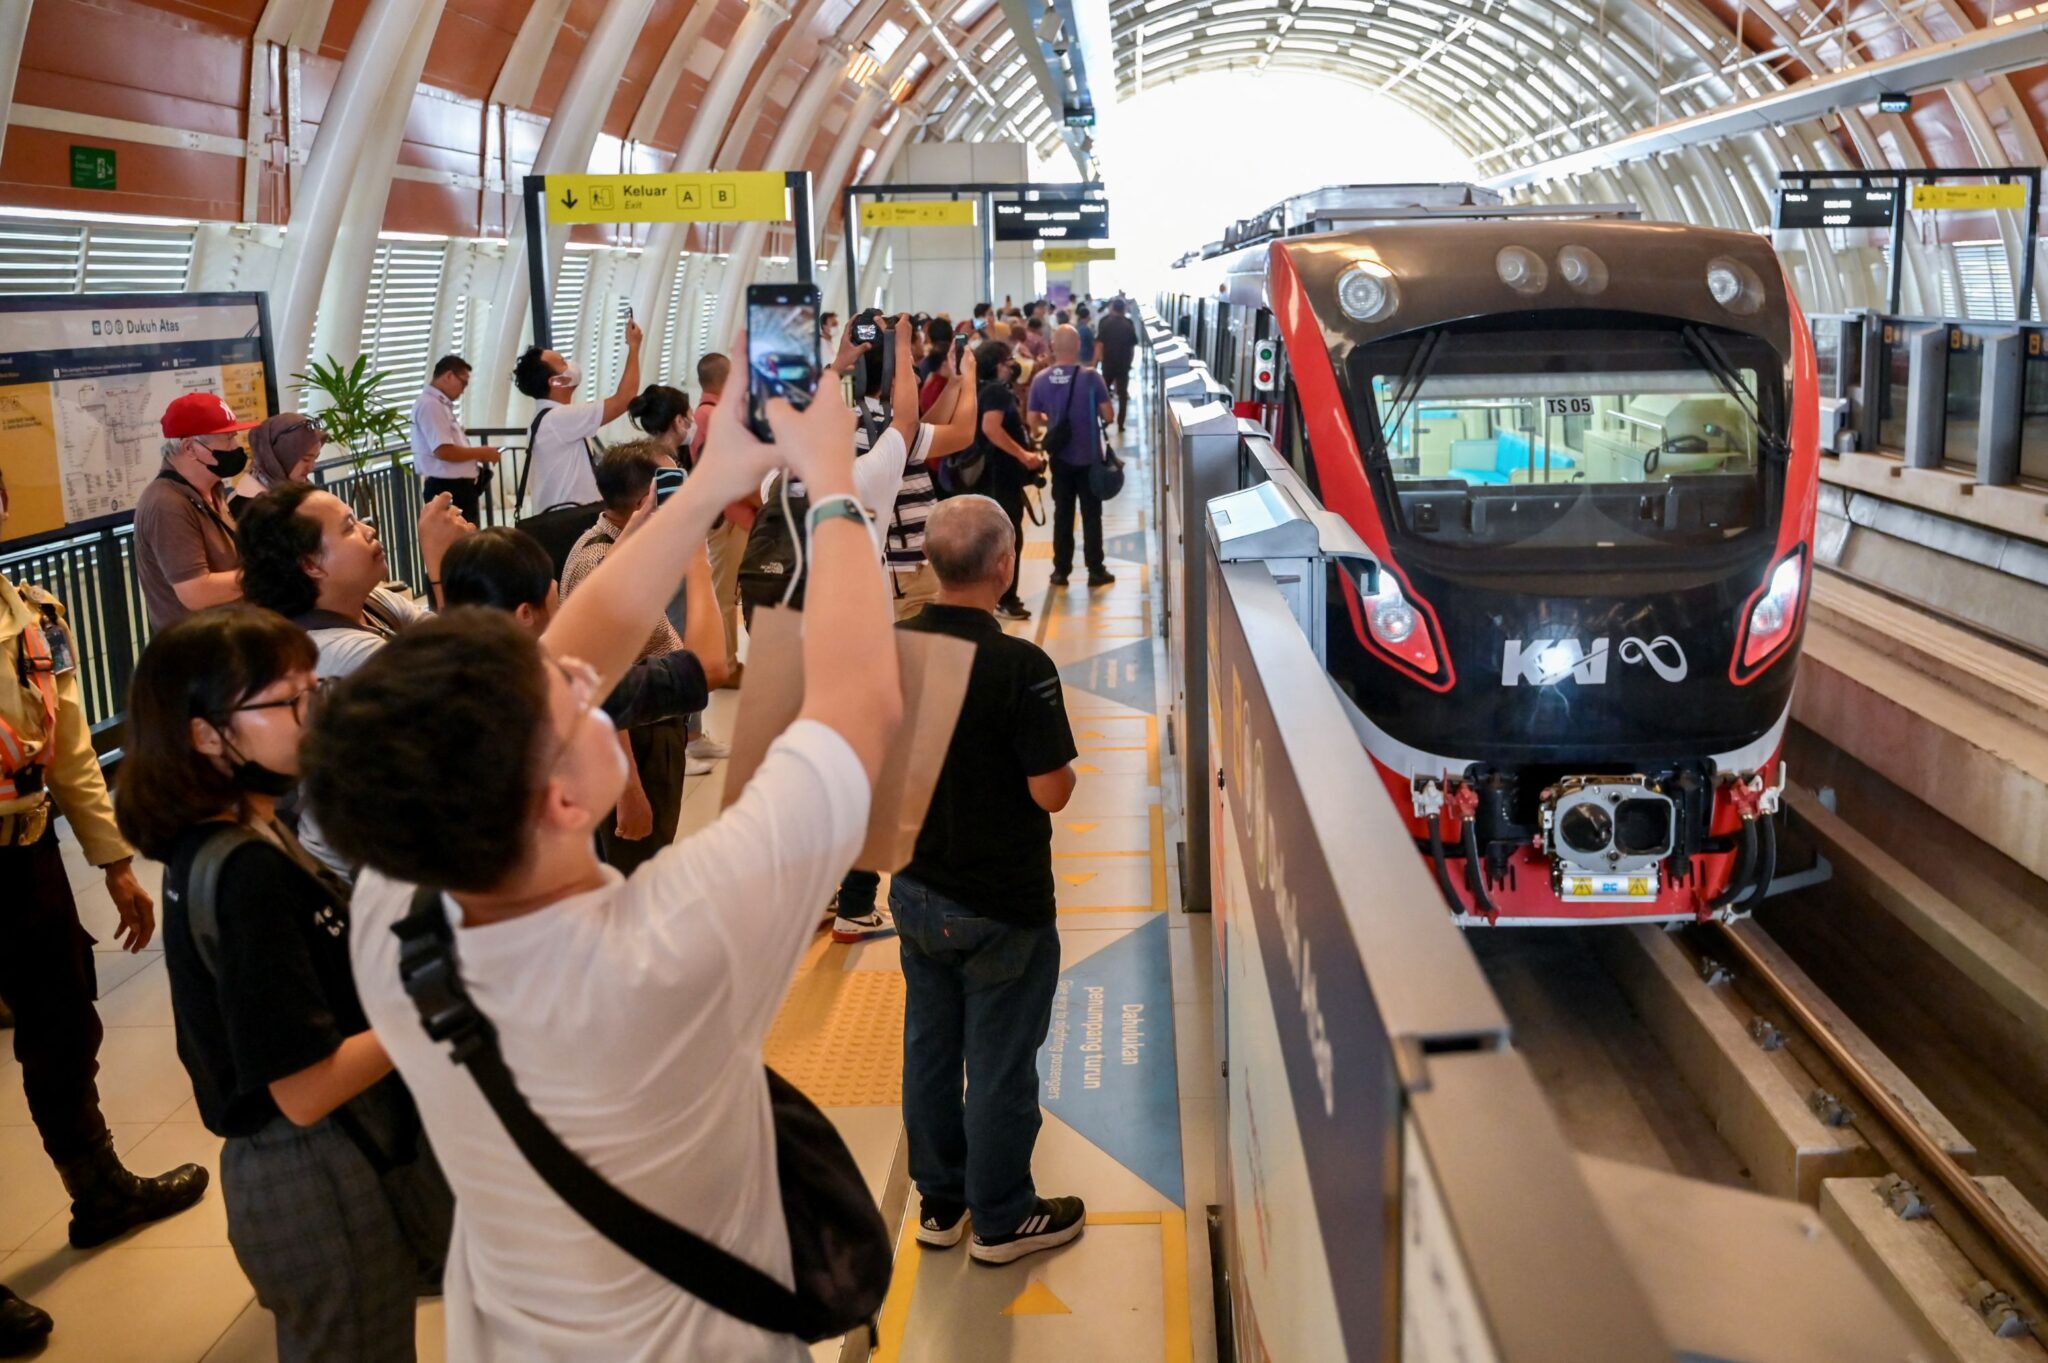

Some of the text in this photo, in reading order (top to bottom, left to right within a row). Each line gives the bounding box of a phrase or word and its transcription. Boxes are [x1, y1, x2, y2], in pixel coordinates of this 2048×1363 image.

[623, 185, 727, 202] Keluar A B
[625, 201, 642, 210] Exit
[127, 318, 180, 334] Dukuh Atas
[1547, 398, 1591, 414] TS 05
[1079, 986, 1106, 1089] penumpang turun
[1121, 1003, 1145, 1065] Dahulukan
[1044, 1053, 1063, 1100] passengers
